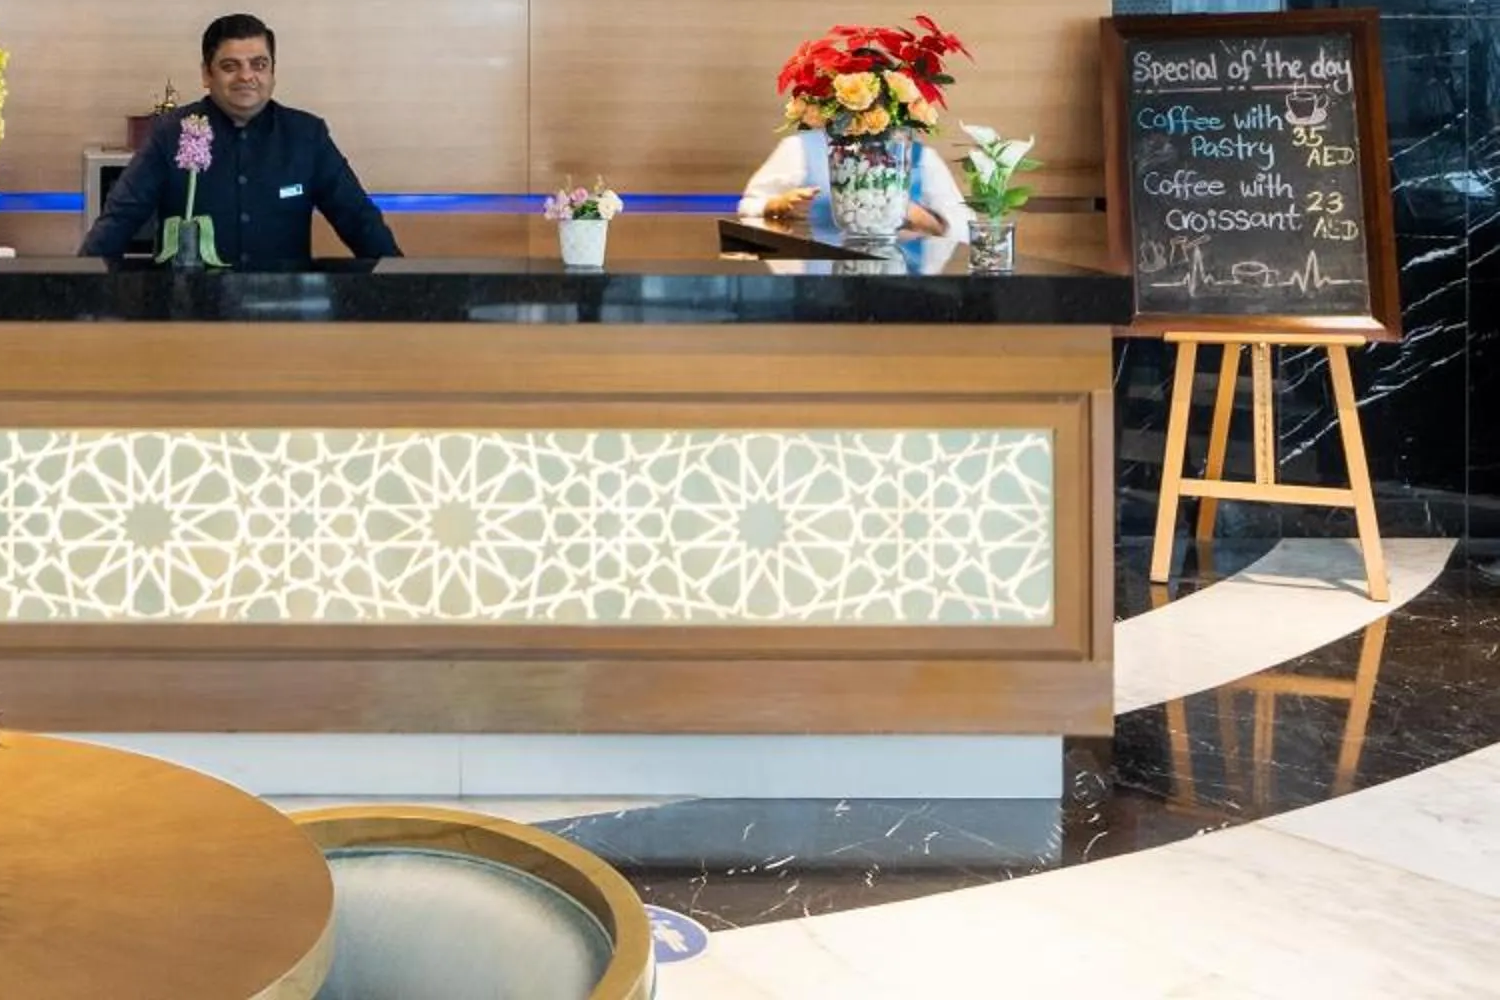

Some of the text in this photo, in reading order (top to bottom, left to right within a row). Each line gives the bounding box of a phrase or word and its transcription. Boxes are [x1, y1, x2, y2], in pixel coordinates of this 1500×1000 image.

[1132, 48, 1353, 92] Special of the day
[1138, 103, 1284, 135] Coffee with
[1291, 125, 1324, 146] 35
[1191, 136, 1275, 170] Pastry
[1307, 147, 1355, 168] AED
[1143, 169, 1294, 200] Coffee with
[1307, 191, 1345, 214] 23
